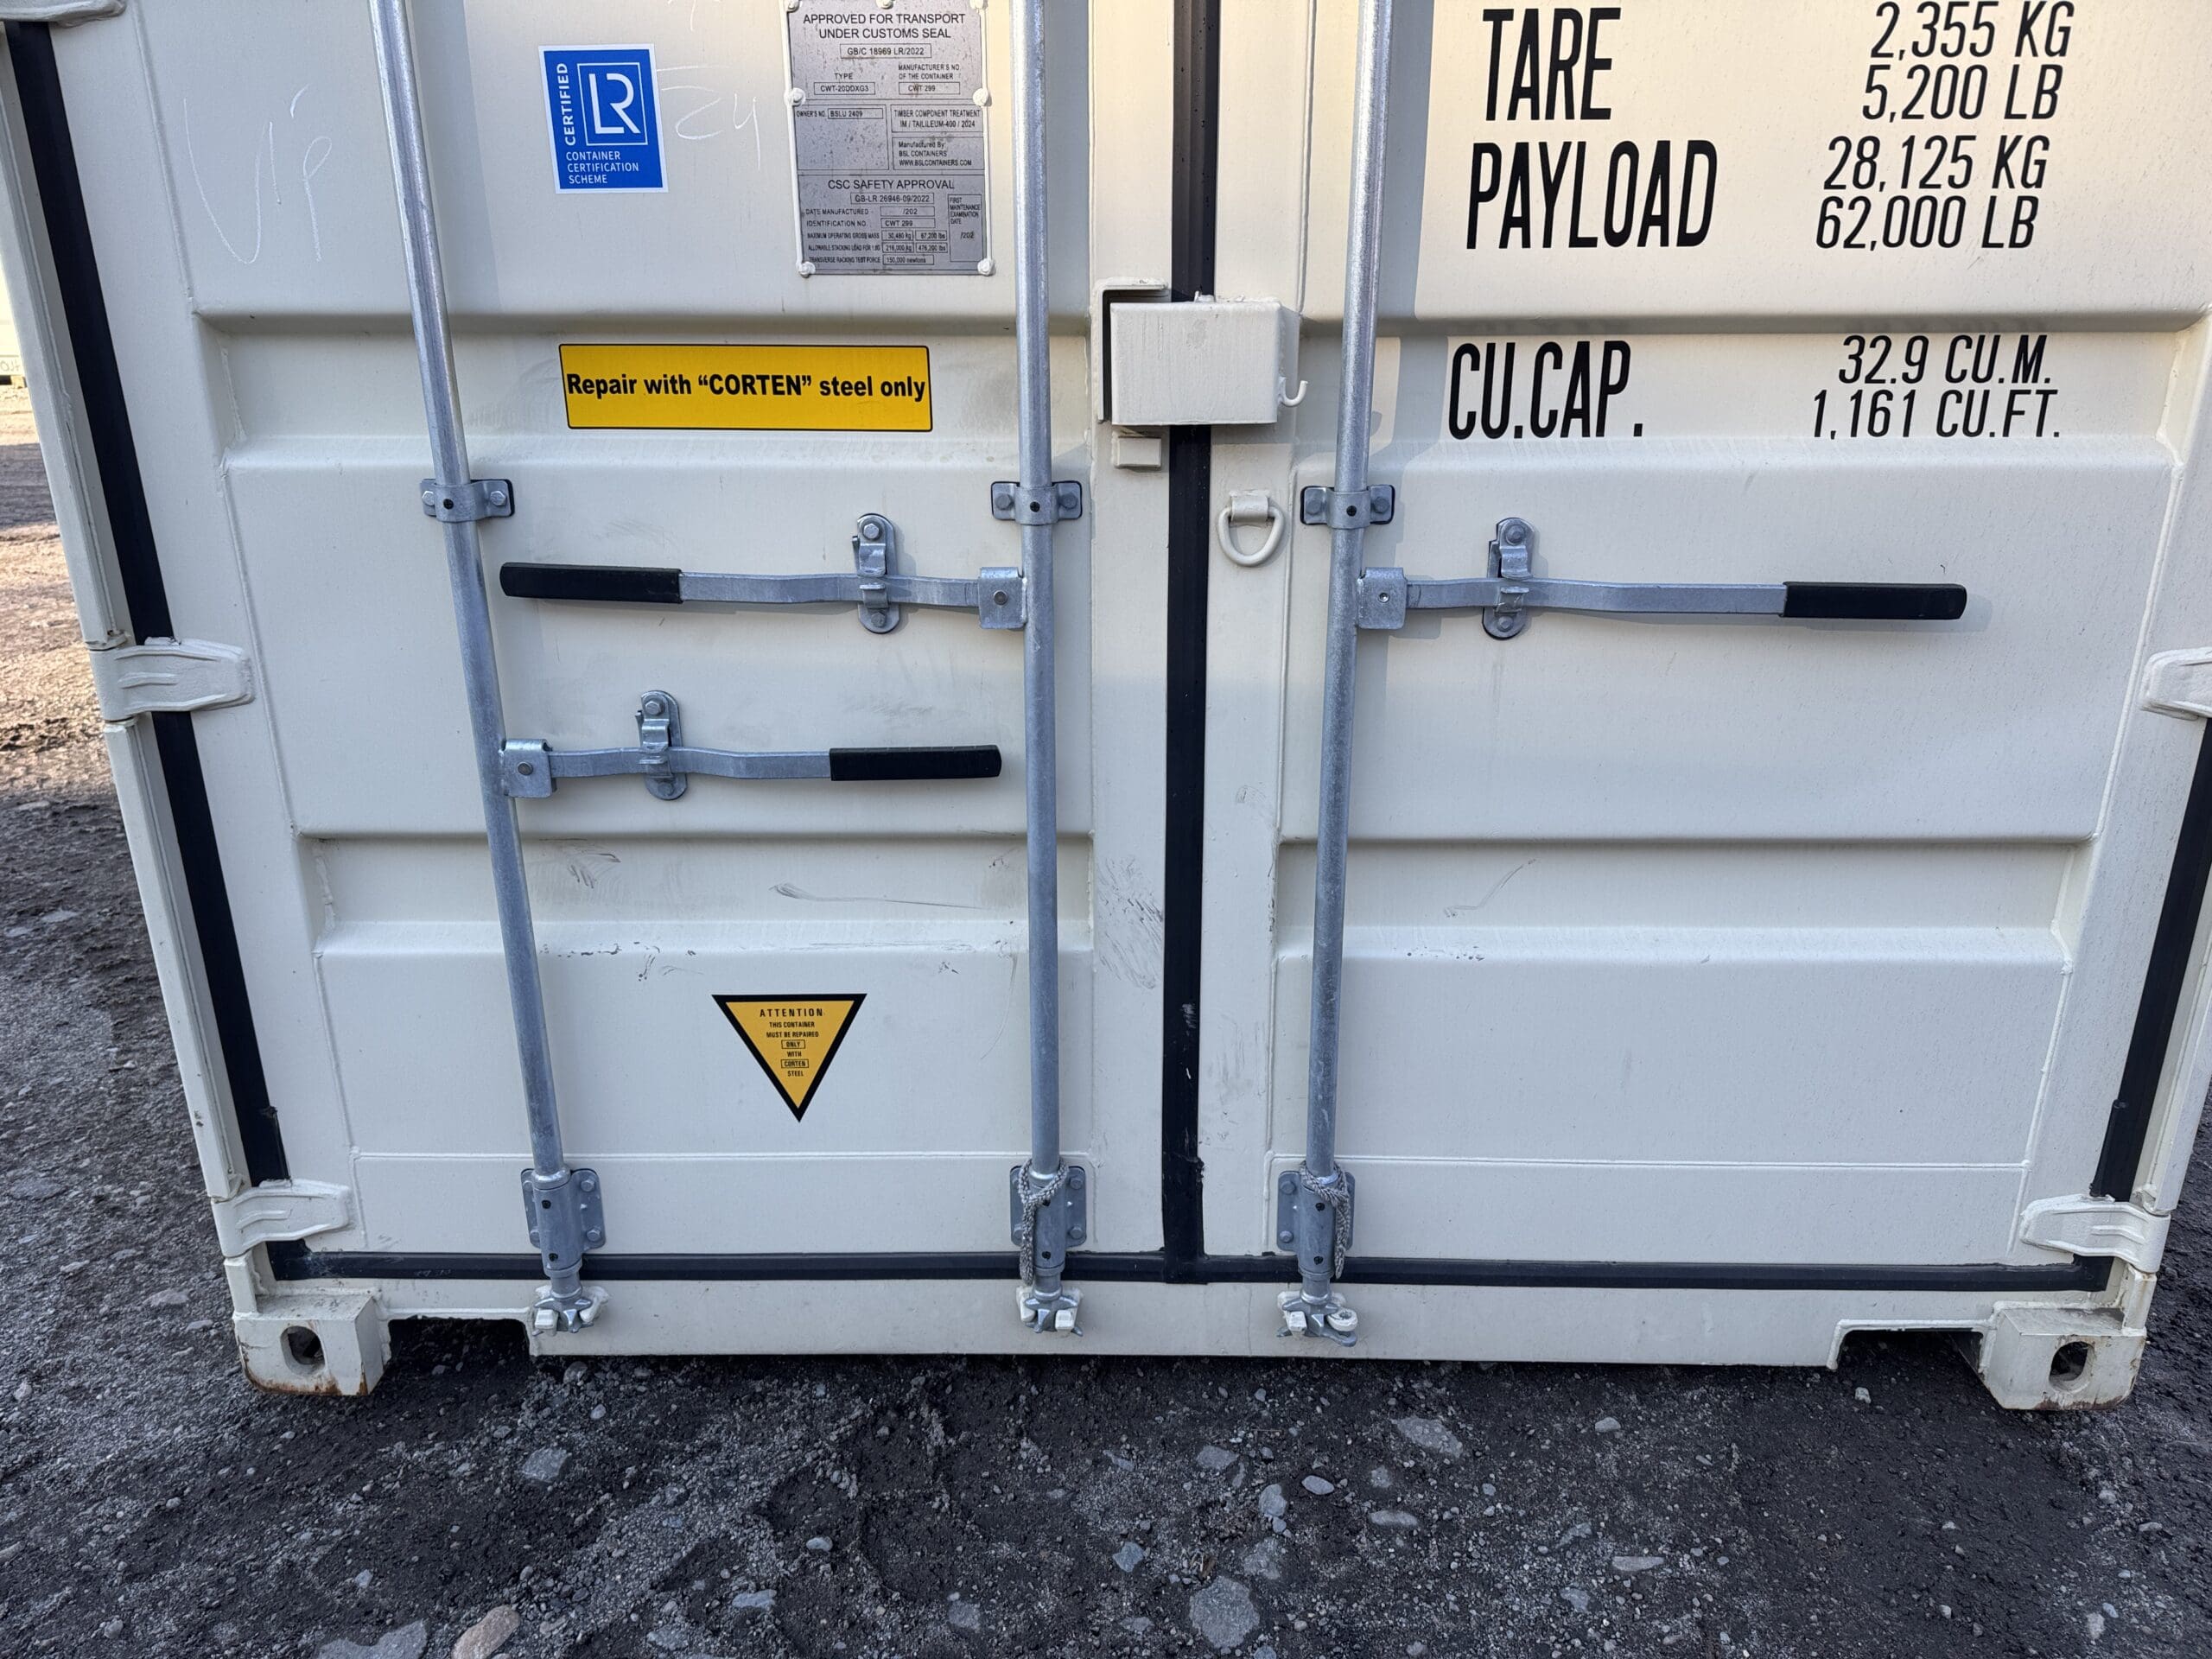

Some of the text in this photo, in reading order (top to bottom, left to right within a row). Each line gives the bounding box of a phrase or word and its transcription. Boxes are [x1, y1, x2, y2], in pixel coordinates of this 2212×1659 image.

[803, 13, 966, 24] APPROVED FOR TRANSPORT
[819, 29, 951, 39] UNDER CUSTOMS SEAL
[1871, 1, 2075, 60] 2,355 KG
[1483, 7, 1621, 121] TARE
[556, 63, 576, 146] CERTIFIED
[588, 73, 641, 135] LR
[894, 109, 981, 118] TIMBER COMPONENT TREATMENT
[1862, 64, 2063, 123] 5,200 LB
[566, 150, 621, 162] CONTAINER
[567, 162, 639, 173] CERTIFICATION
[569, 175, 608, 184] SCHEME
[1823, 135, 2050, 193] 28,125 KG
[828, 179, 955, 189] CSC SAFETY APPROVAL
[1466, 140, 1718, 250] PAYLOAD
[1816, 195, 2039, 251] 62,000 LB
[1839, 334, 2051, 385] 32.9 CU.M.
[568, 373, 637, 399] Repair
[644, 374, 692, 395] with
[819, 376, 874, 397] steel
[880, 377, 925, 403] only
[1448, 340, 1643, 440] CU.CAP.
[1814, 389, 2060, 439] 1,161 CU.FT.
[760, 1008, 823, 1018] ATTENTION
